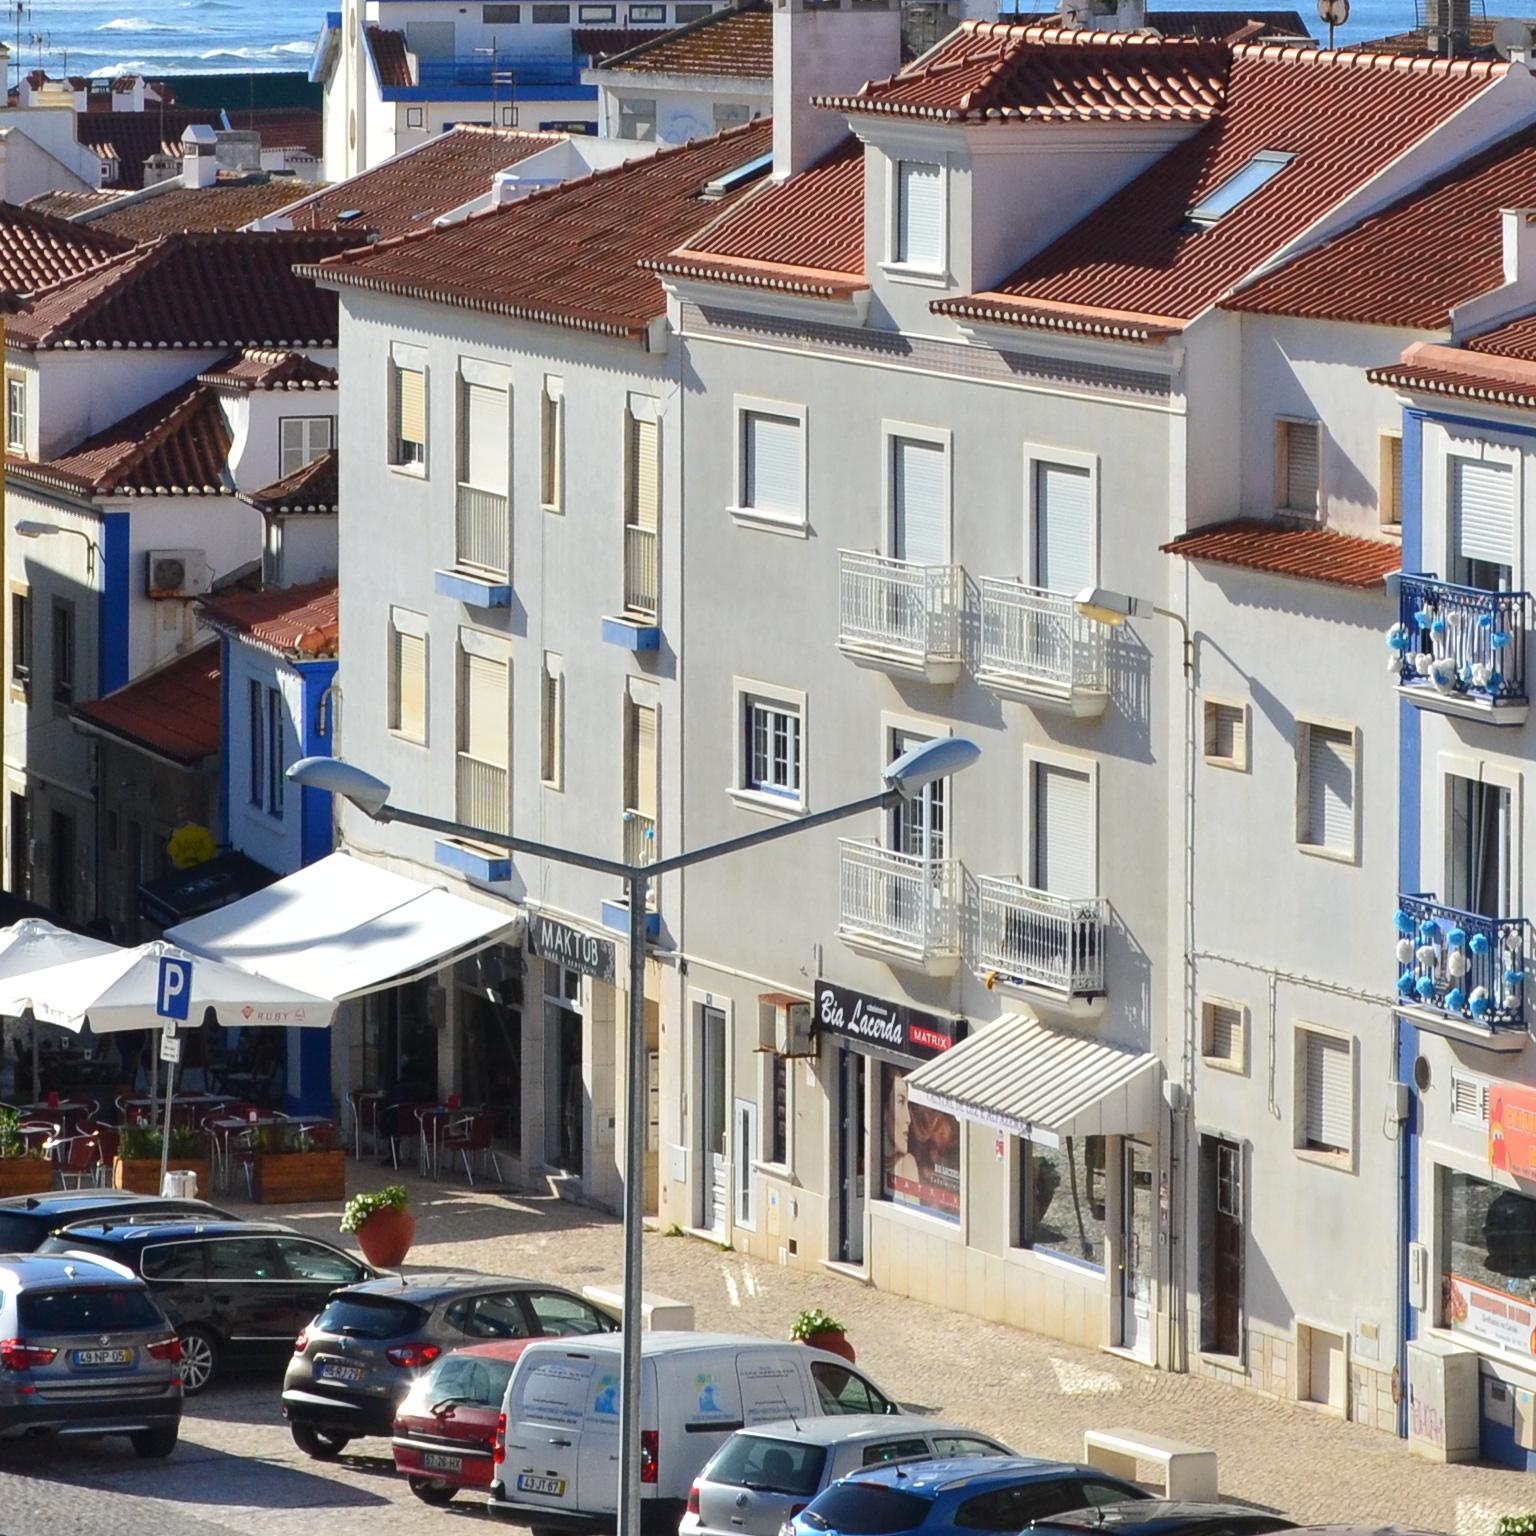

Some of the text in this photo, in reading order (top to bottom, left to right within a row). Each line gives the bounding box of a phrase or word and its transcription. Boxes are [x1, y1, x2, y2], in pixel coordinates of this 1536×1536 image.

[541, 920, 598, 966] MAKTUB
[163, 963, 184, 1012] P
[257, 1014, 289, 1022] RUBY
[820, 990, 947, 1048] Bia Lacerda MATRIX
